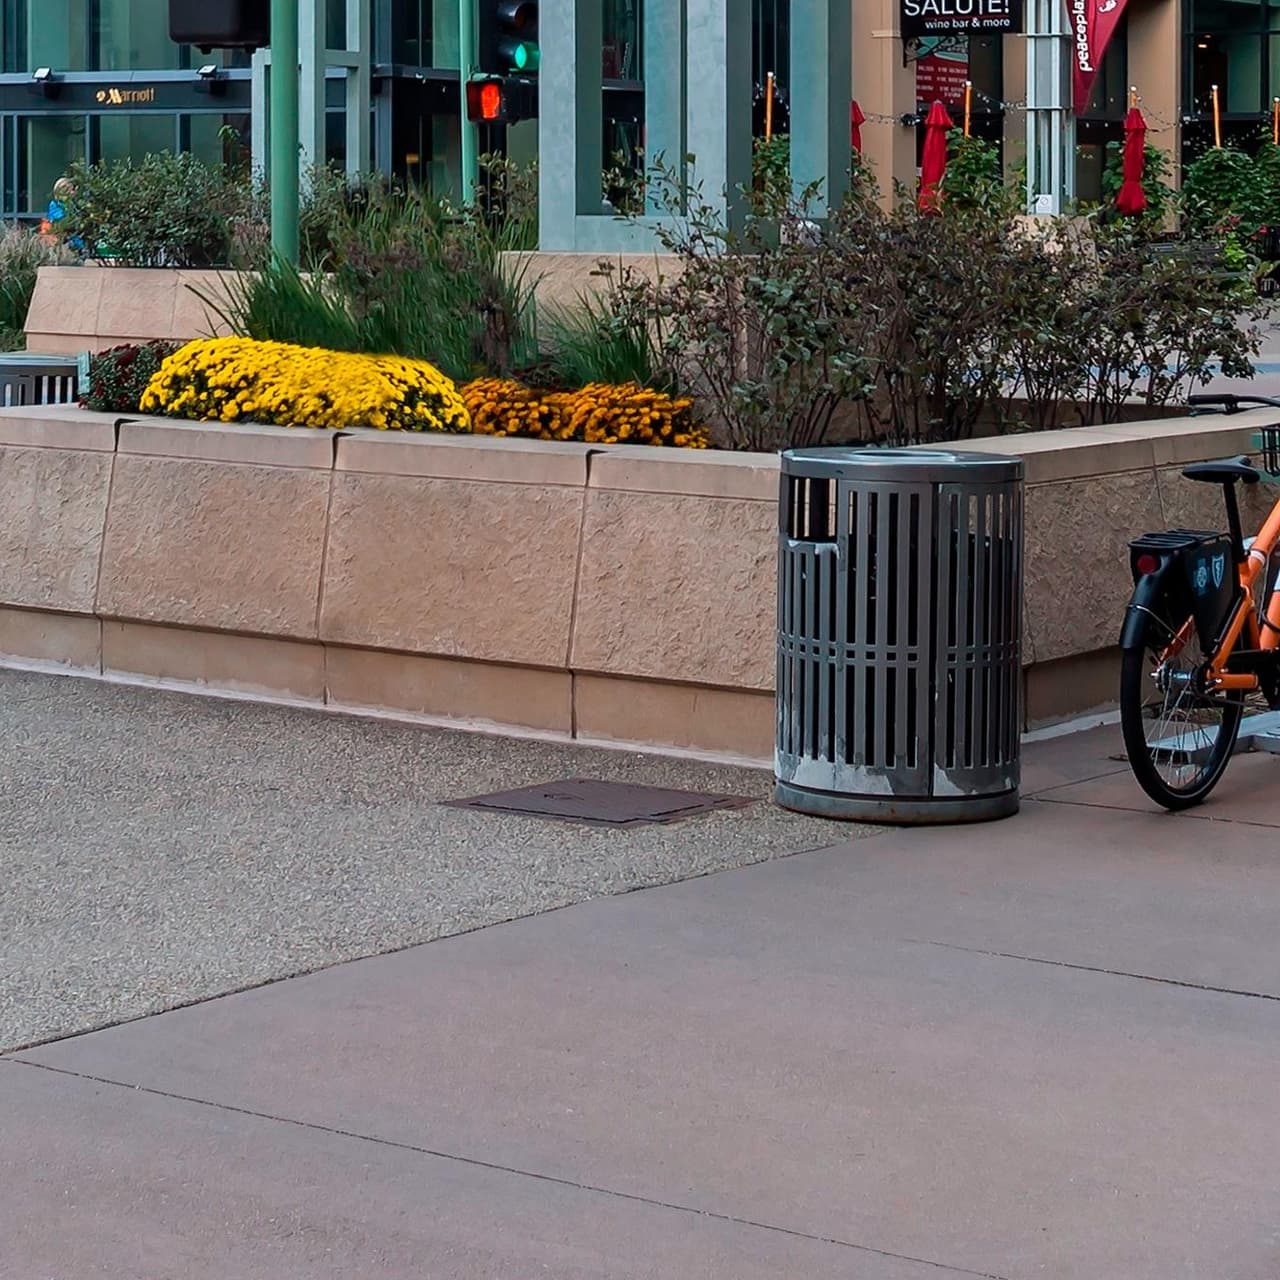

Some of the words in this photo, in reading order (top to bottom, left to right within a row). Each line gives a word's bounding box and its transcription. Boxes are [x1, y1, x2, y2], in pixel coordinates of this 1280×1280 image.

[925, 18, 950, 29] wine
[952, 18, 969, 28] bar
[971, 17, 981, 28] &
[983, 18, 1010, 27] more
[106, 87, 155, 105] Marriott
